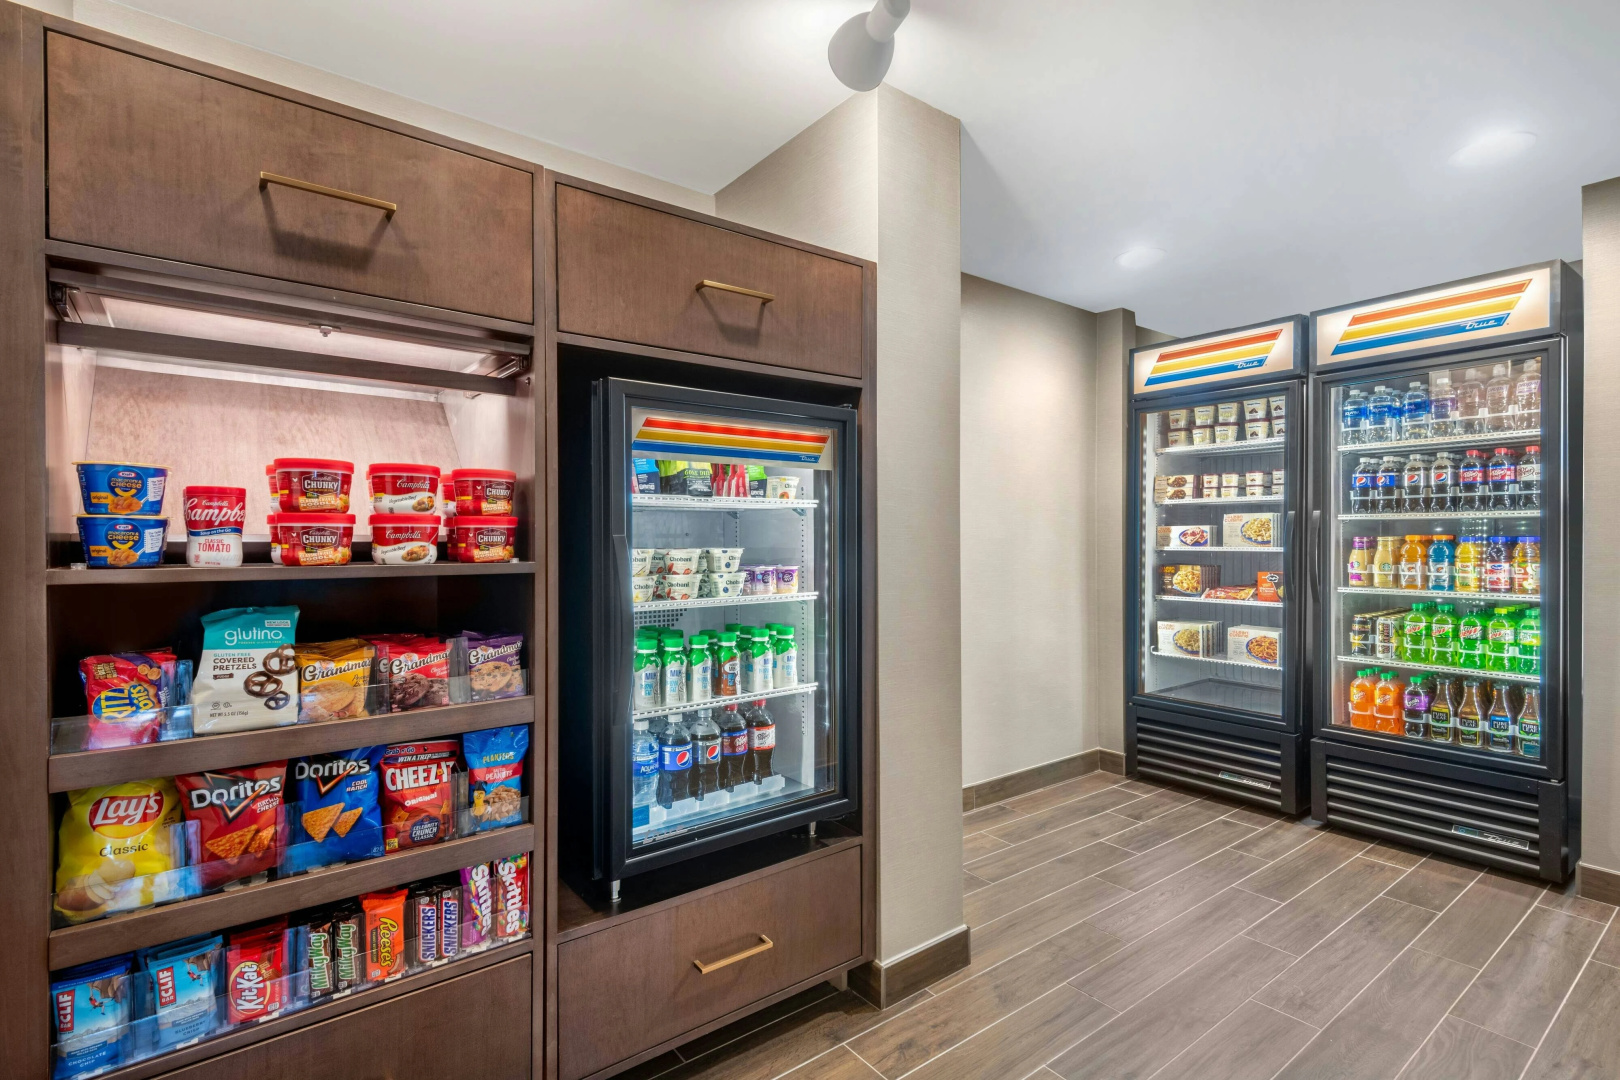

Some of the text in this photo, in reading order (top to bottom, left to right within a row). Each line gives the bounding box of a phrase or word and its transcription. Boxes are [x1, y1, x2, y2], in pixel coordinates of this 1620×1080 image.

[304, 480, 338, 489] CHUNKY
[486, 488, 510, 496] CHUNKY
[198, 543, 231, 552] TOMATO
[303, 535, 337, 544] CHUNKY
[224, 627, 282, 645] glutino
[213, 663, 257, 671] PRETZELS
[130, 684, 153, 710] bits
[100, 689, 136, 723] RITZ
[483, 752, 516, 764] PLANTERS
[295, 760, 370, 779] Doritos
[486, 770, 512, 780] PEANUTS
[191, 777, 281, 808] Doritos
[346, 784, 368, 792] RANCH
[93, 792, 161, 826] Lay's
[412, 826, 438, 838] CRUNCH
[498, 862, 522, 934] Skittles
[422, 908, 436, 960] SNICKERS
[444, 902, 458, 955] SNICKERS
[379, 917, 398, 967] Reese's
[159, 970, 172, 997] CLIF
[58, 994, 72, 1022] CLIF
[174, 1020, 206, 1034] BLUEBERRY
[183, 1027, 200, 1036] CRISP
[68, 1051, 106, 1066] CHOCOLATE
